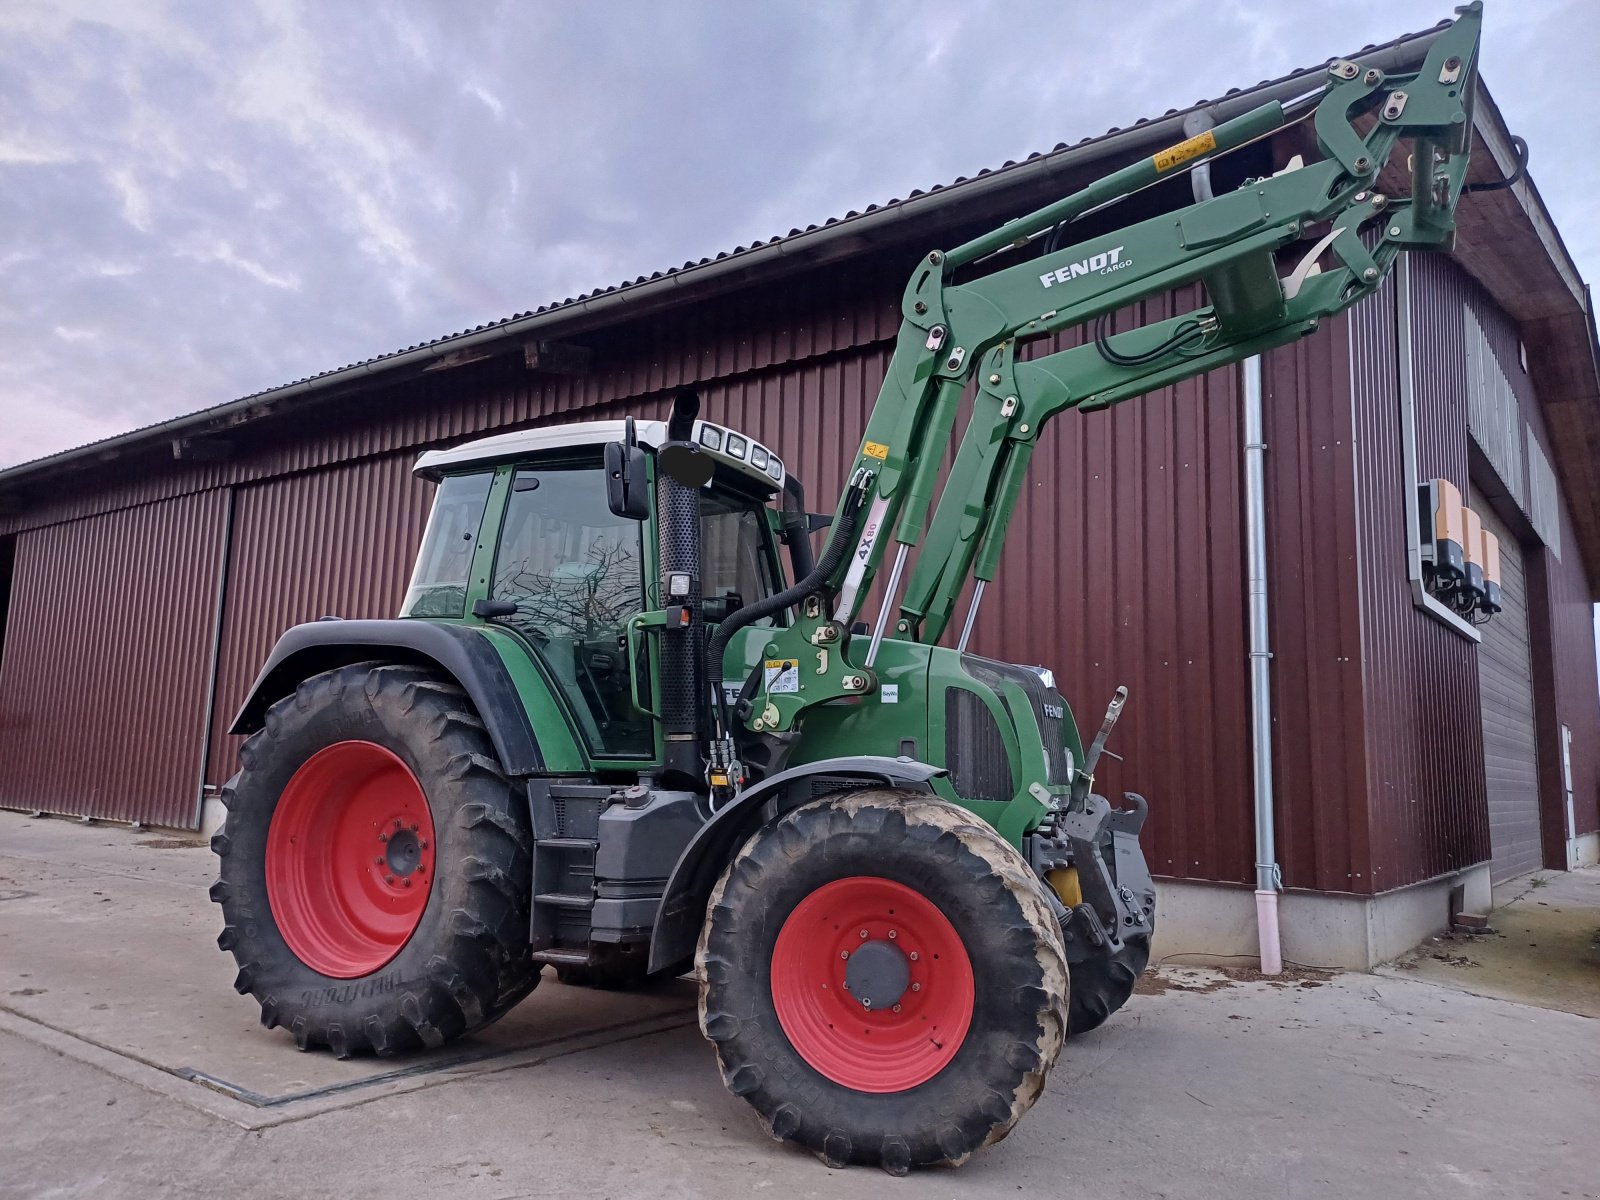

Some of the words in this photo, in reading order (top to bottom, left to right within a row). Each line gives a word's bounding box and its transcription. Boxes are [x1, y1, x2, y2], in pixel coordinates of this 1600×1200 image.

[1039, 245, 1124, 289] FENDT
[1100, 259, 1133, 276] CARGO
[858, 538, 873, 560] 4X
